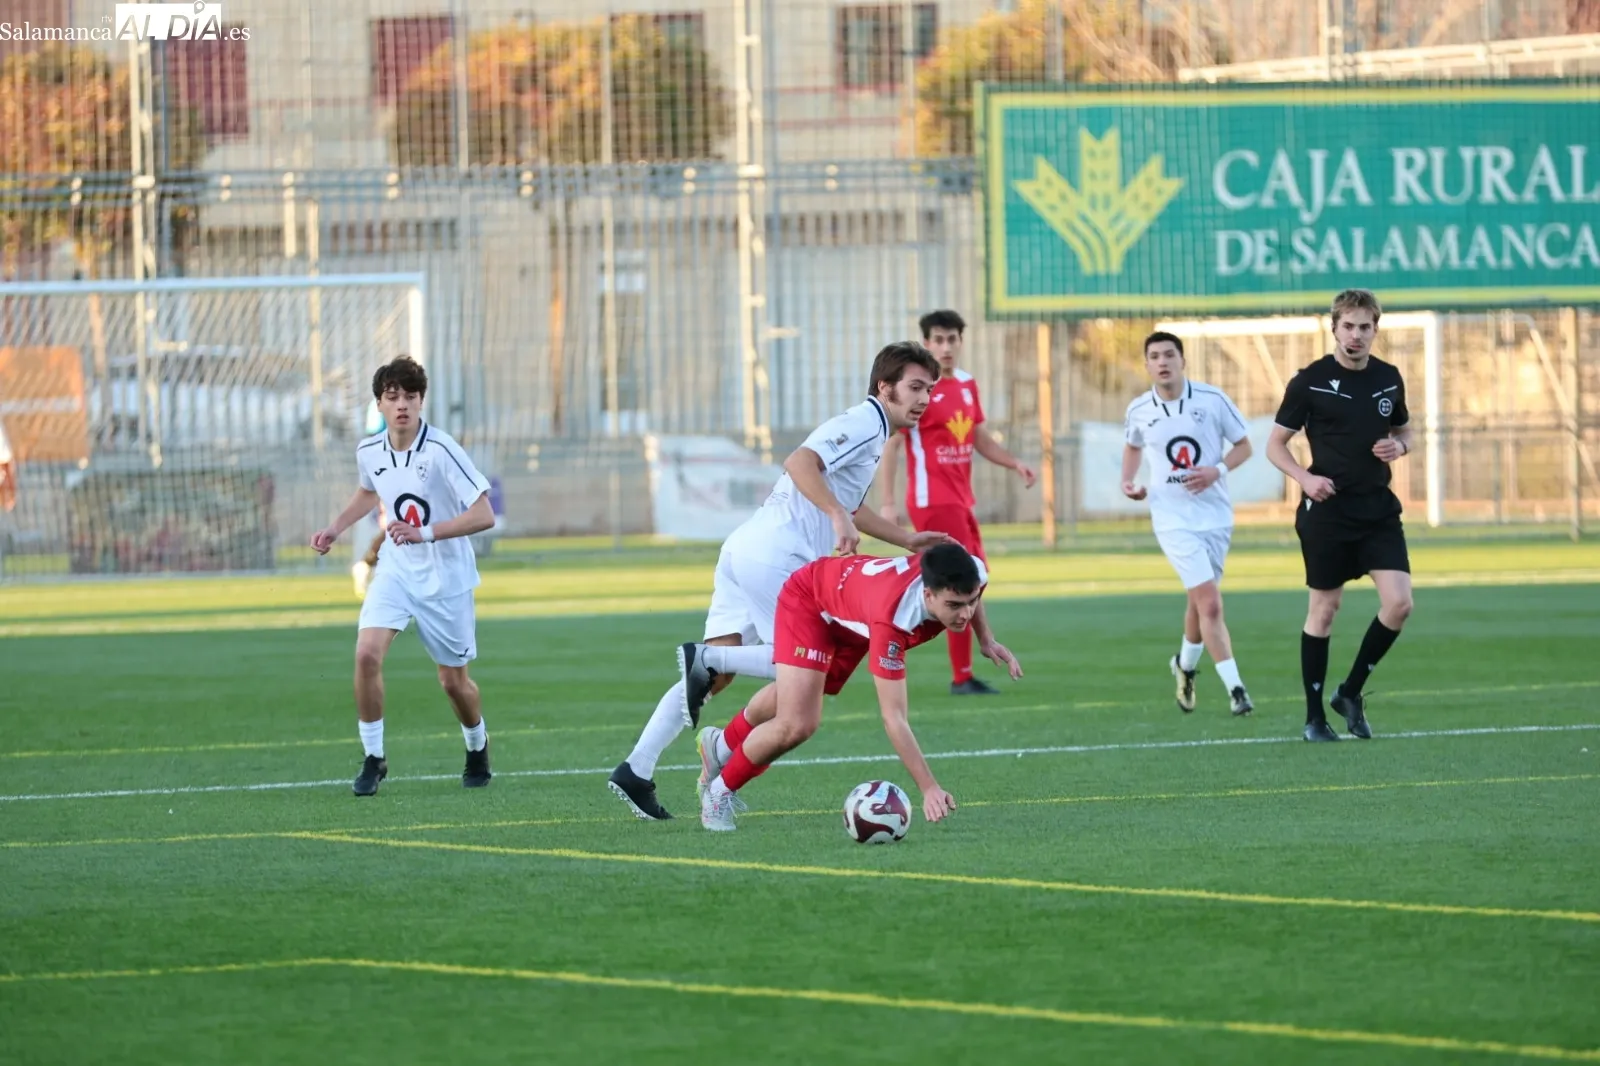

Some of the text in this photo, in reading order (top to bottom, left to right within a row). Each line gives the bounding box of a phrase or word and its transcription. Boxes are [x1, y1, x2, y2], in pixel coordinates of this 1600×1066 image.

[1212, 143, 1600, 224] CAJA RURAL
[1215, 222, 1600, 276] DE SALAMANCA
